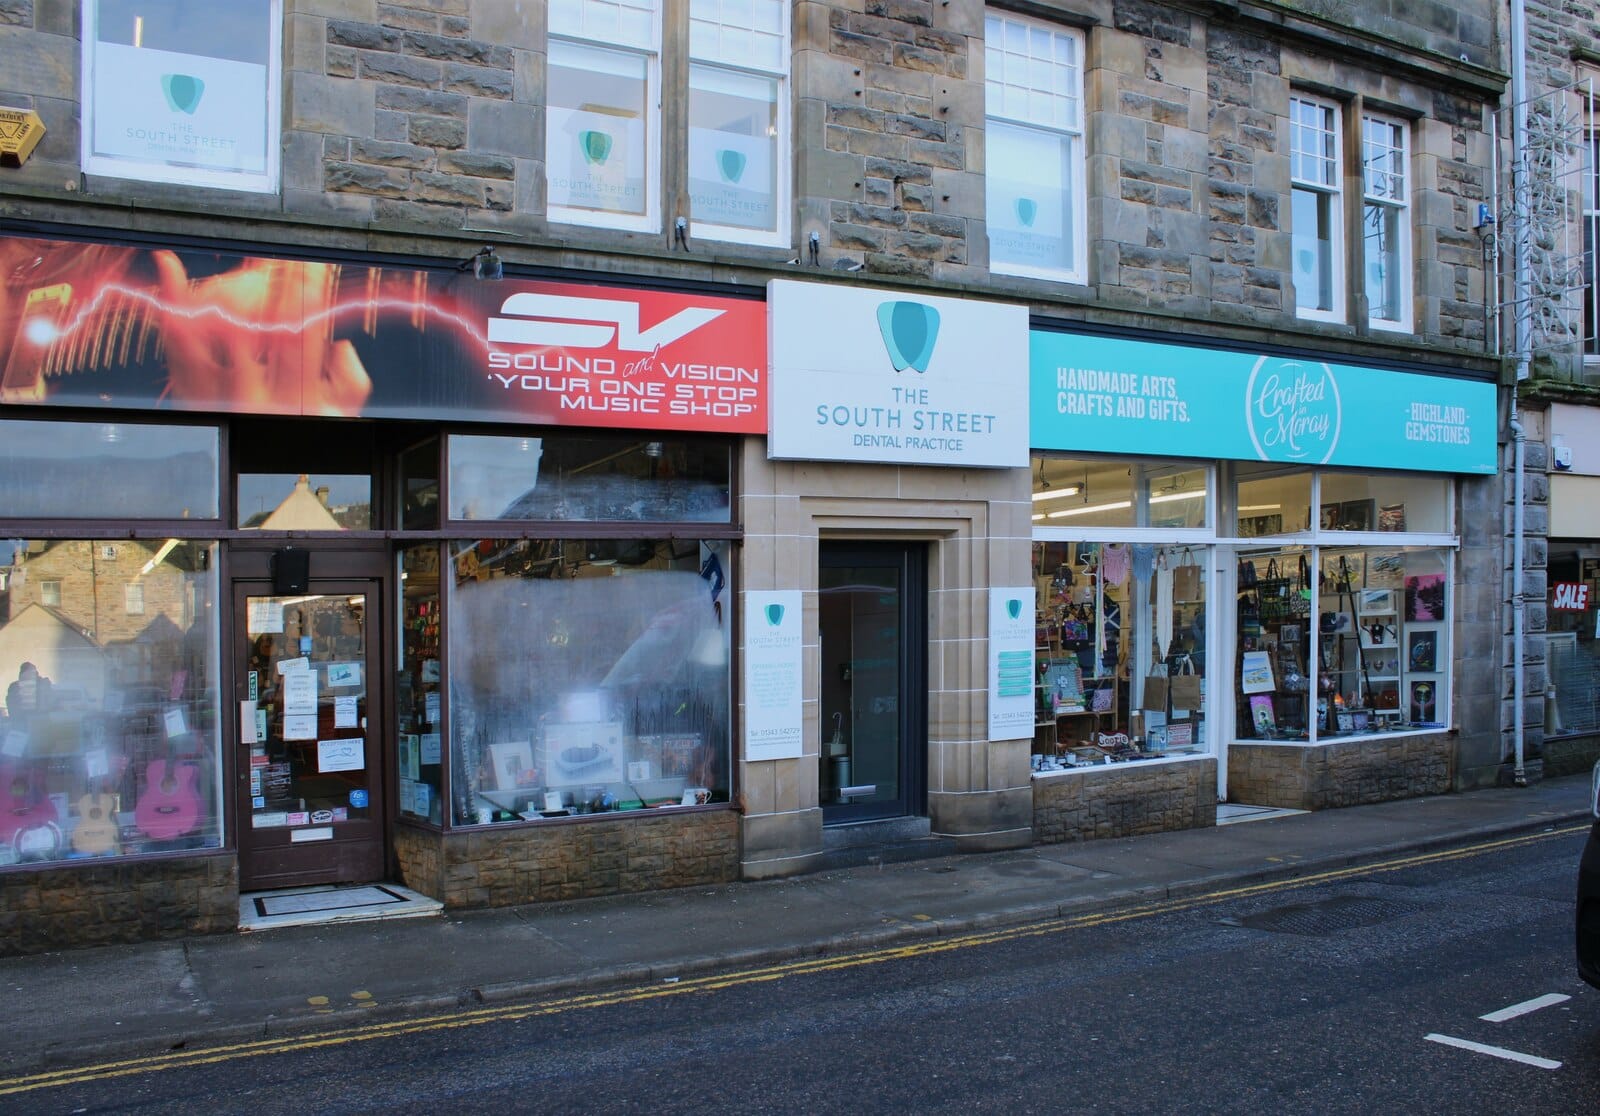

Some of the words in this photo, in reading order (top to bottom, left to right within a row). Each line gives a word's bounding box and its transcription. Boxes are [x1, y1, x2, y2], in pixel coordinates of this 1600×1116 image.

[126, 127, 177, 142] SOUTH
[183, 134, 236, 149] STREET
[488, 352, 615, 375] SOUND
[622, 343, 661, 378] and
[660, 362, 759, 383] VISION
[600, 379, 666, 398] ONE
[675, 384, 758, 401] STOP
[892, 387, 929, 405] THE
[1056, 367, 1138, 395] HANDMADE
[1141, 375, 1178, 400] ARTS,
[1254, 372, 1325, 418] Crafted
[560, 394, 660, 413] MUSIC
[1057, 391, 1113, 417] CRAFTS
[1117, 396, 1145, 419] AND
[1149, 398, 1190, 422] GIFTS.
[816, 404, 901, 428] SOUTH
[913, 410, 996, 434] STREET
[1264, 410, 1329, 451] Moray
[853, 434, 901, 449] DENTAL
[905, 437, 963, 451] PRACTICE
[1405, 421, 1471, 445] GEMSTONES
[1553, 583, 1588, 609] SALE
